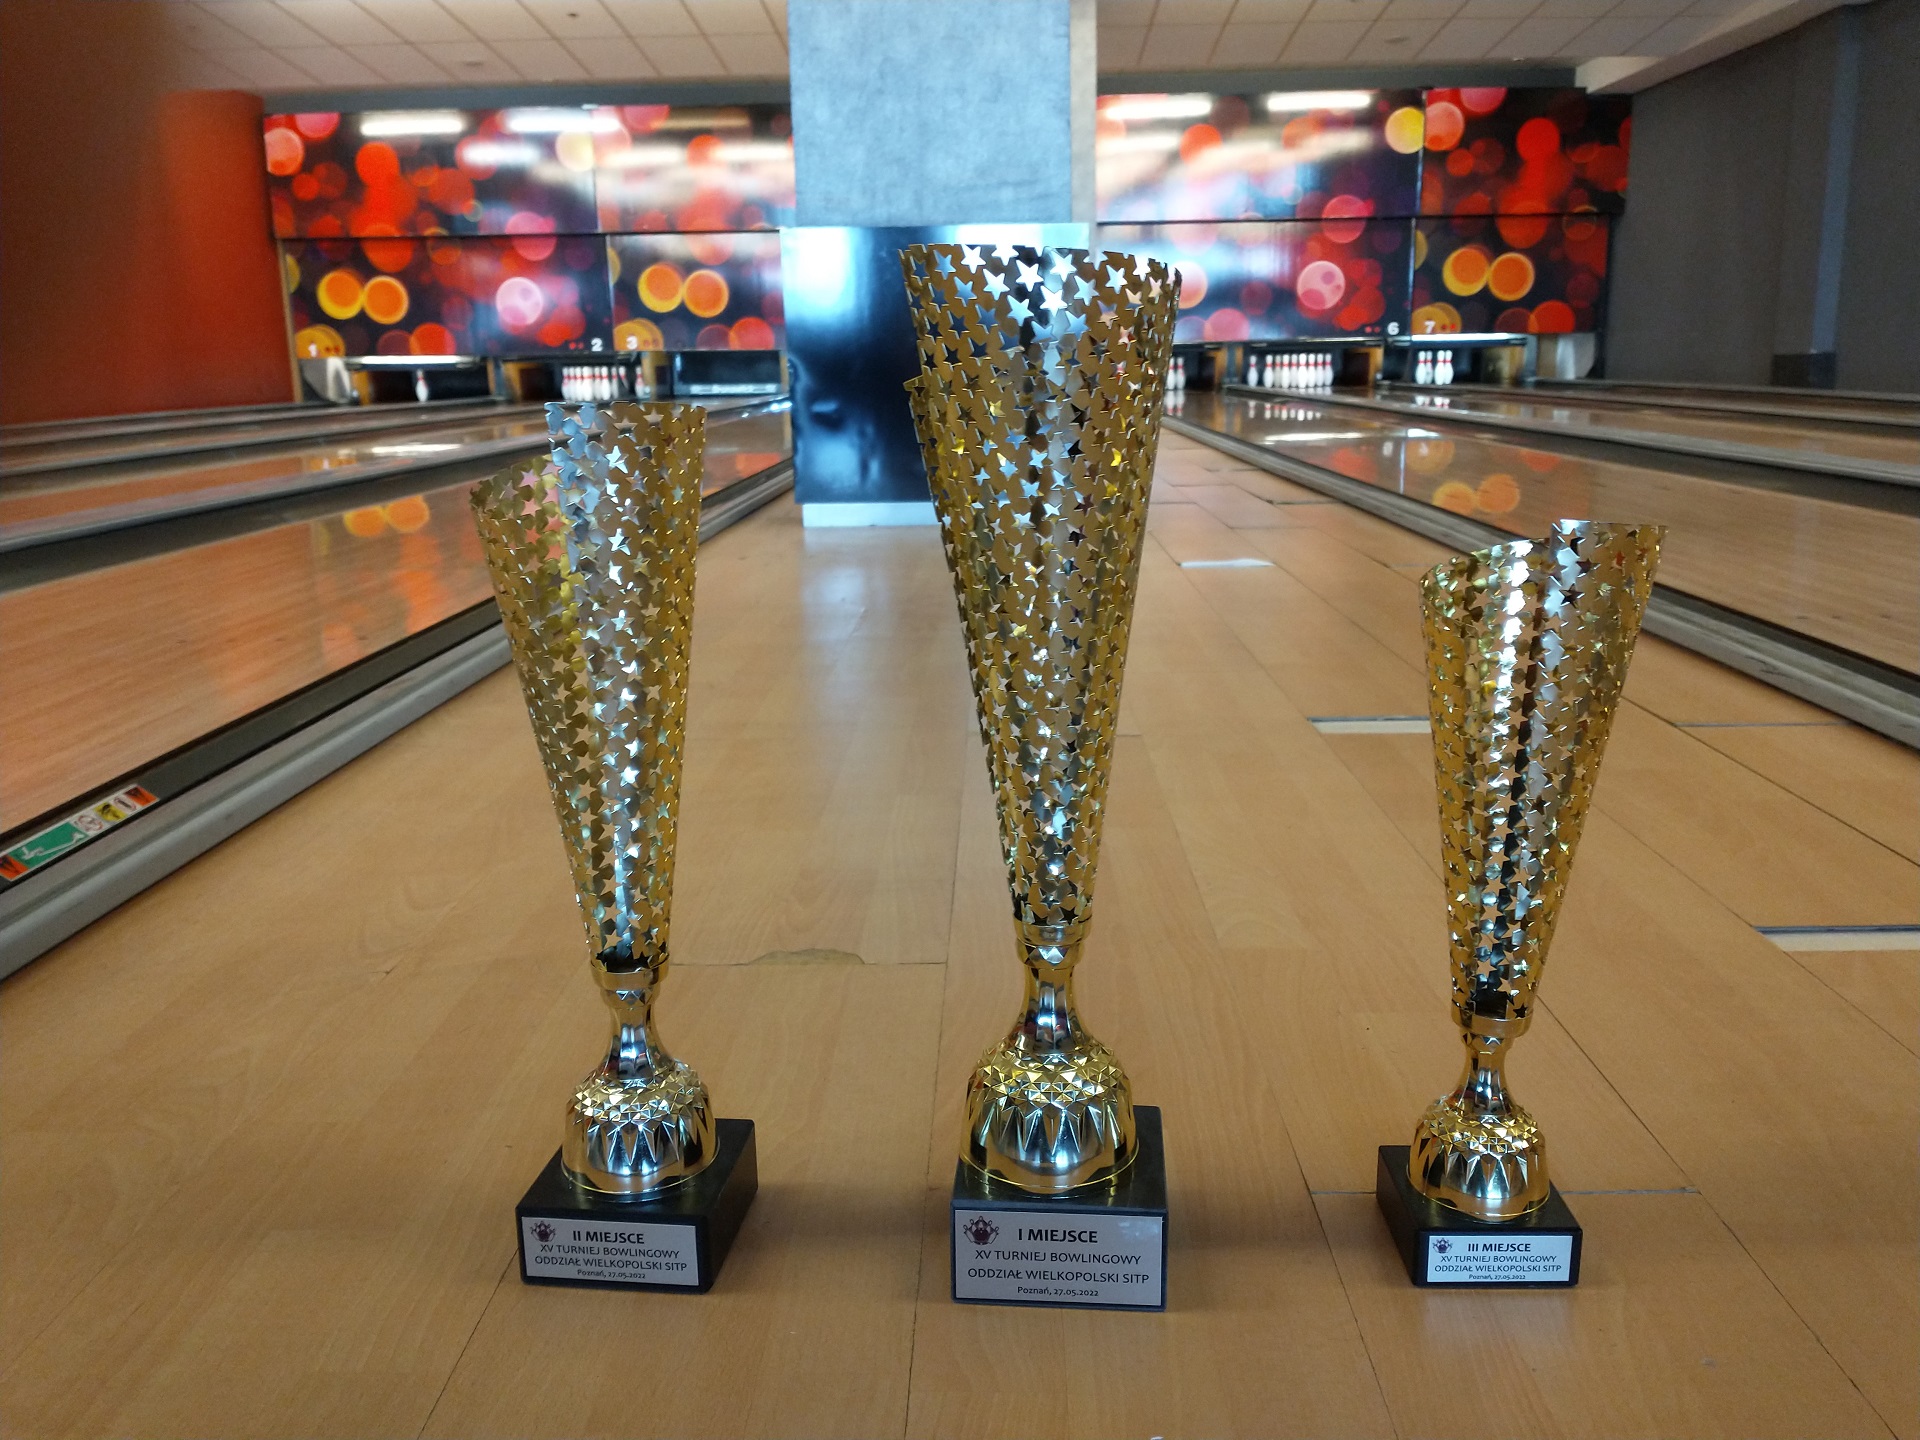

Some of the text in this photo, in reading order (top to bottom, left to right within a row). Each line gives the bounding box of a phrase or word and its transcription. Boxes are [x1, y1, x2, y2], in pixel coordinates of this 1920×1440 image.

[1387, 321, 1400, 336] 6
[1424, 320, 1436, 334] 7
[591, 337, 603, 352] 2
[626, 335, 639, 350] 3
[573, 1230, 645, 1244] II MIEJSCE
[1018, 1228, 1098, 1244] I MIEJSCE
[540, 1244, 680, 1259] XV TURNIEJ BOWLINGOWY
[1467, 1243, 1531, 1252] III MIEJSCE
[535, 1255, 687, 1272] ODDZIAŁ WIELKOPOLSKI SITP
[975, 1250, 1142, 1265] XV TURNIEJ BOWLINGOWY
[1440, 1255, 1557, 1263] XV TURNIEJ BOWLINGOWY
[577, 1269, 606, 1279] Poznań,
[967, 1268, 1150, 1284] ODDZIAŁ WIELKOPOLSKI SITP
[1017, 1286, 1099, 1297] Poznań, 27.05.2022
